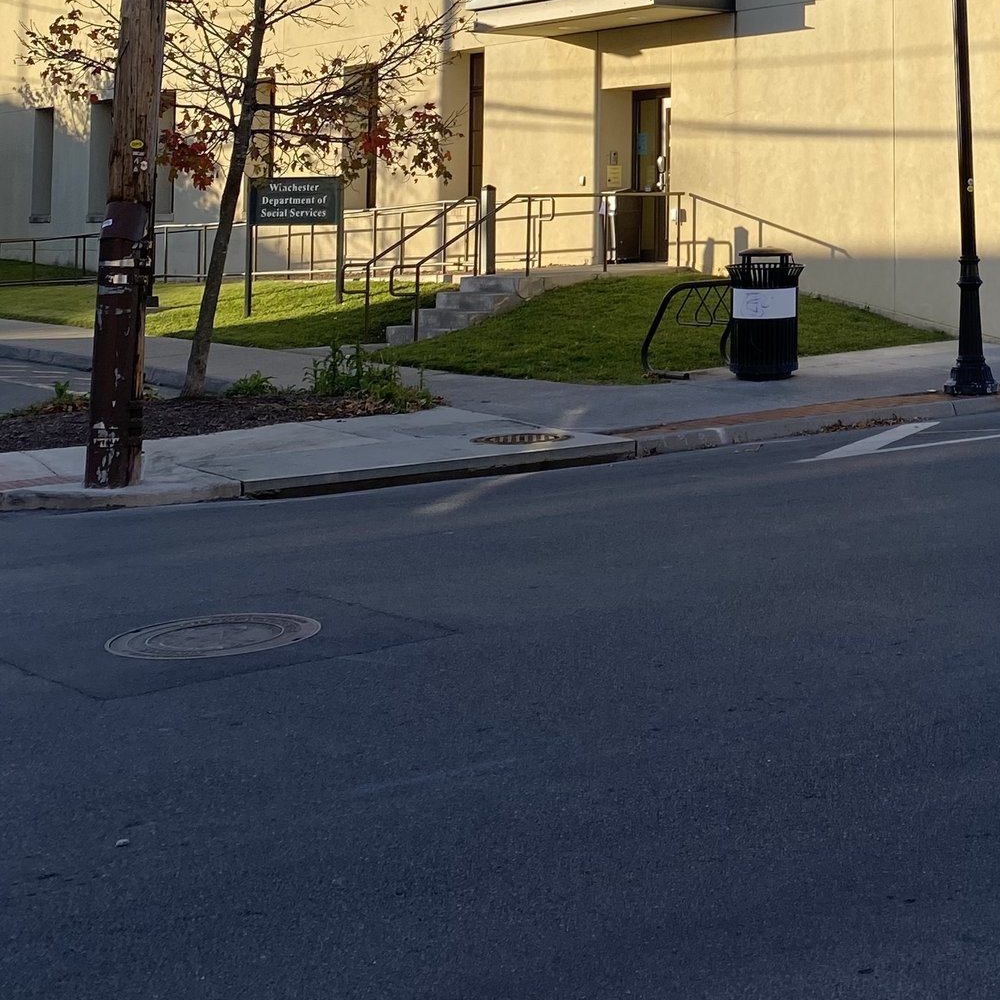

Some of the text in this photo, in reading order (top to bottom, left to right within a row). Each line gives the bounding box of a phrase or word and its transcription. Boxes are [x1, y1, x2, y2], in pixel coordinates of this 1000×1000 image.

[269, 183, 320, 192] Winchester
[262, 195, 328, 207] Department of
[260, 208, 327, 218] Social Services
